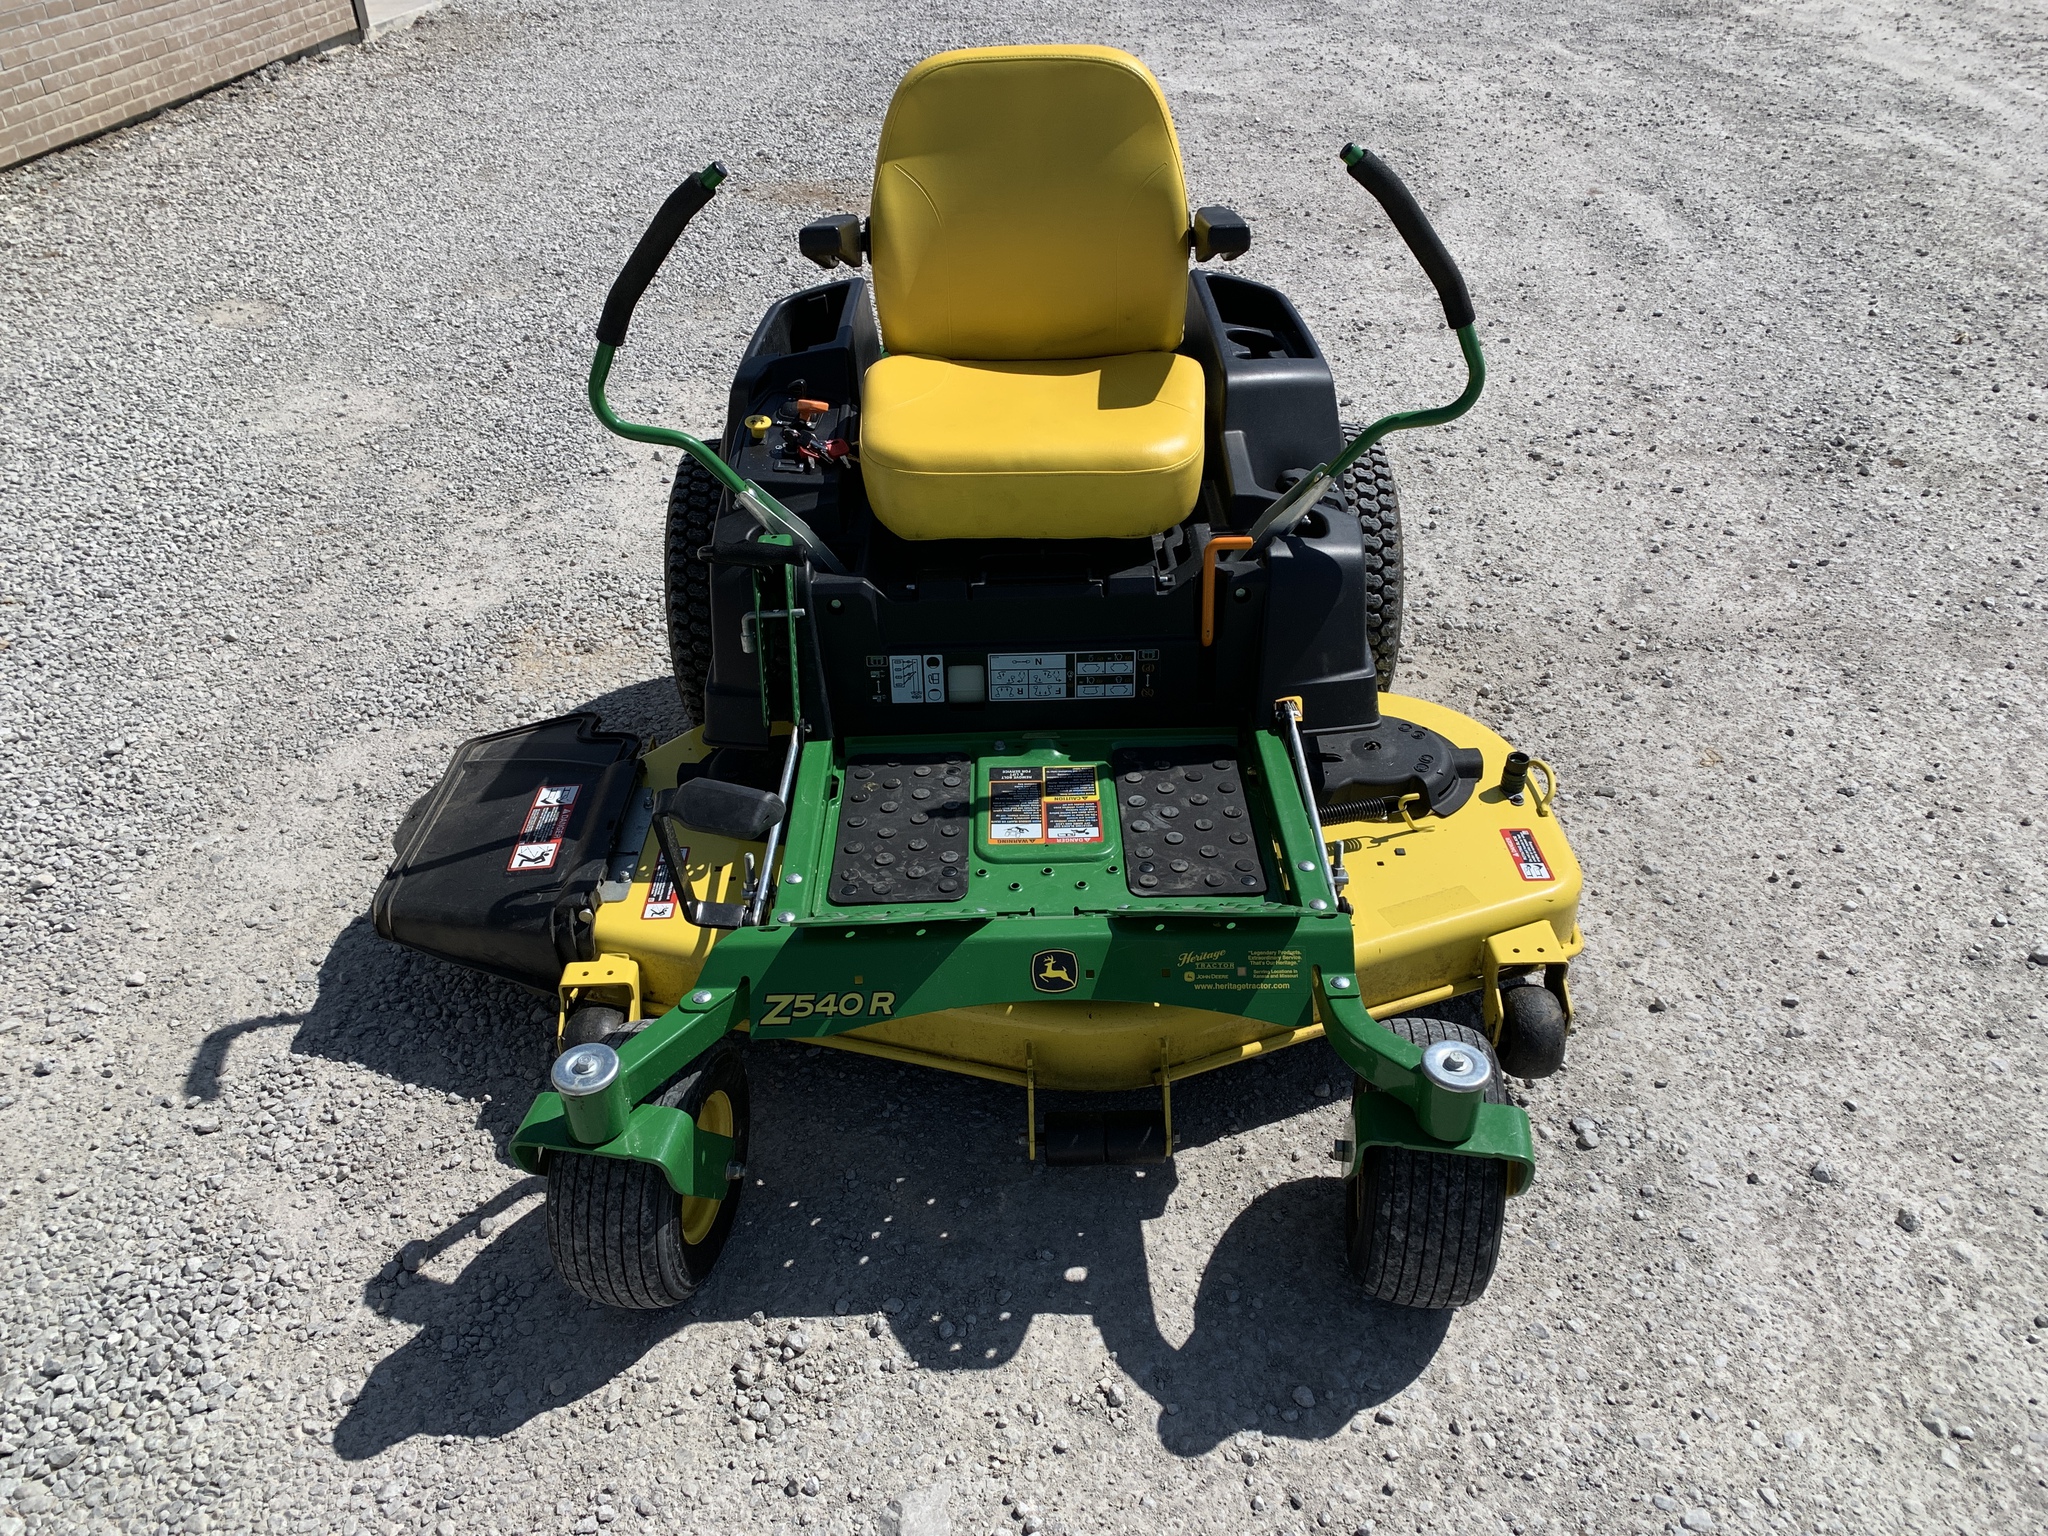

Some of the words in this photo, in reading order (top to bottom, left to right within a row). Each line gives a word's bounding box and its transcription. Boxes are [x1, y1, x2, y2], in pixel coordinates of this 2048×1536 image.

[552, 814, 569, 839] DANGER
[1177, 949, 1227, 967] Heritage
[1194, 982, 1290, 990] www.heritagetractor.com
[759, 991, 864, 1026] Z540
[868, 991, 896, 1016] R
